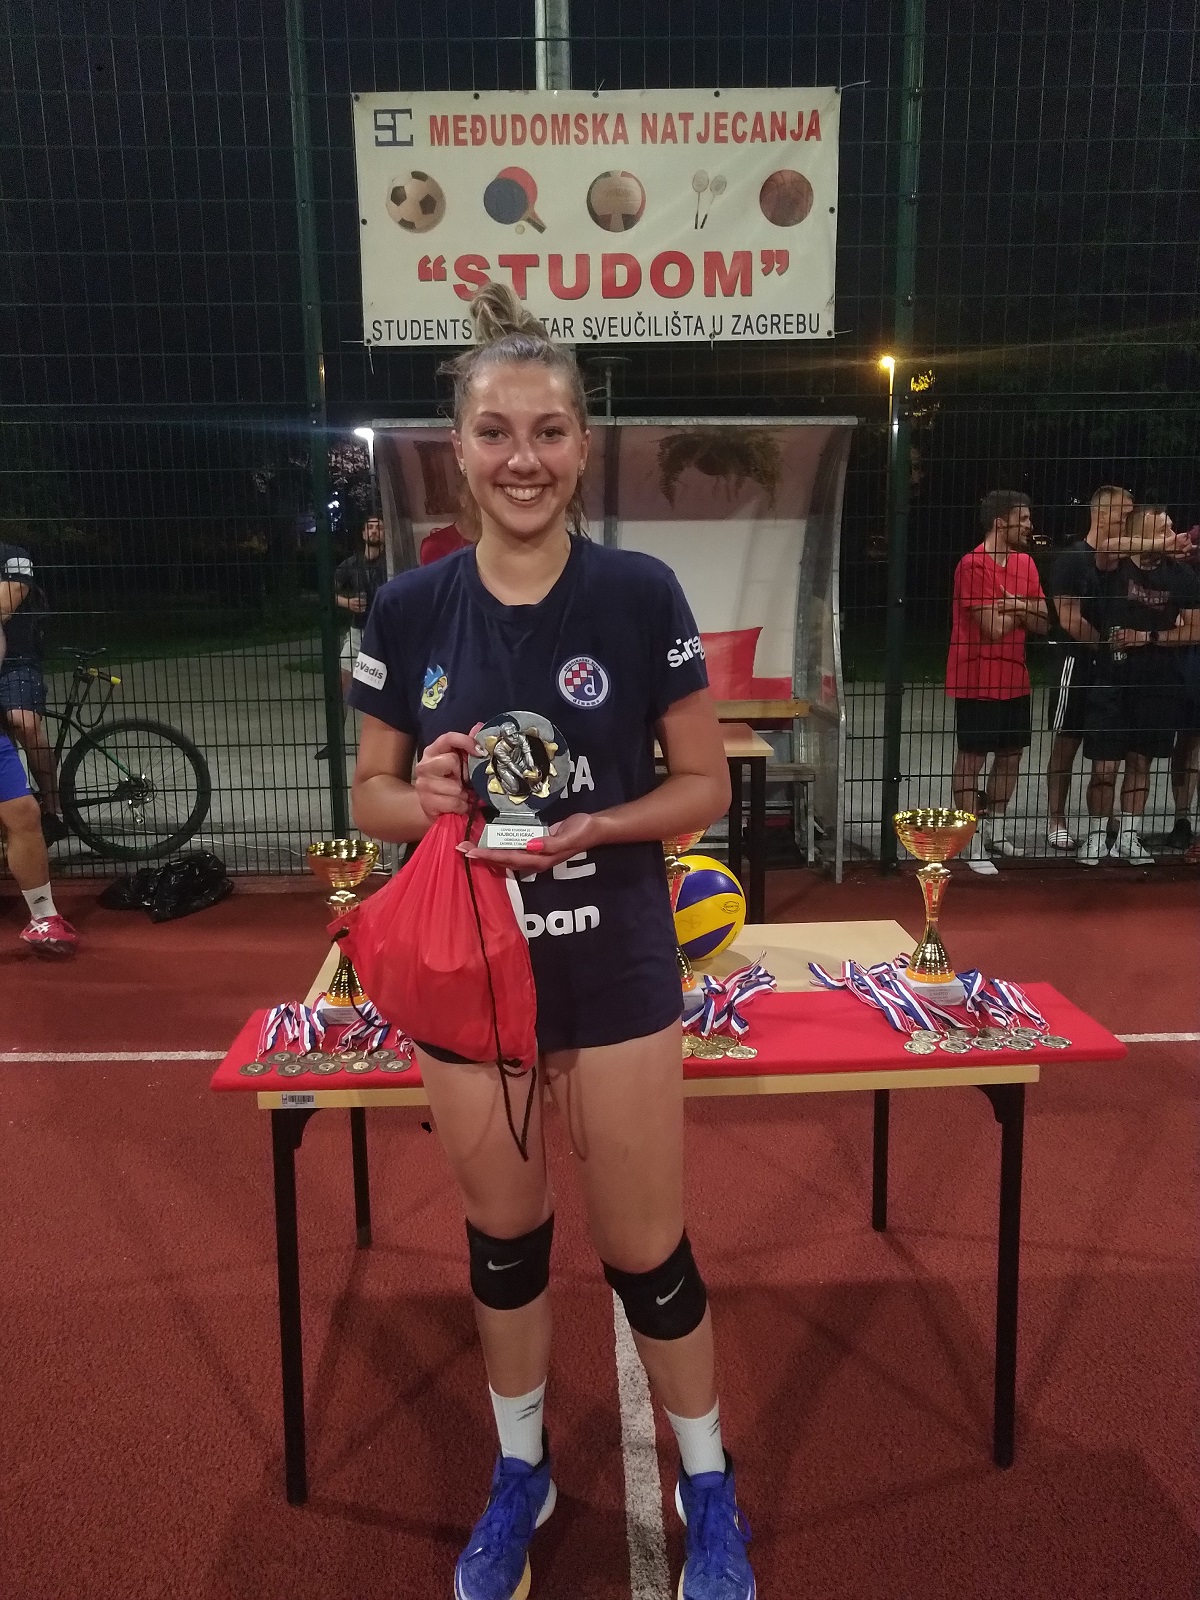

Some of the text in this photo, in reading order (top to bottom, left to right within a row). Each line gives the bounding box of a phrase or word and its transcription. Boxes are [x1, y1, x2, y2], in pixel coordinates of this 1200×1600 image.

[429, 112, 630, 147] MEĐUDOMSKA
[641, 109, 823, 145] NATJECANJA
[372, 311, 821, 341] STUDENTS TAR SVEUČILIŠTA U ZAGREBU
[355, 661, 384, 680] oVadis
[525, 905, 601, 938] ban
